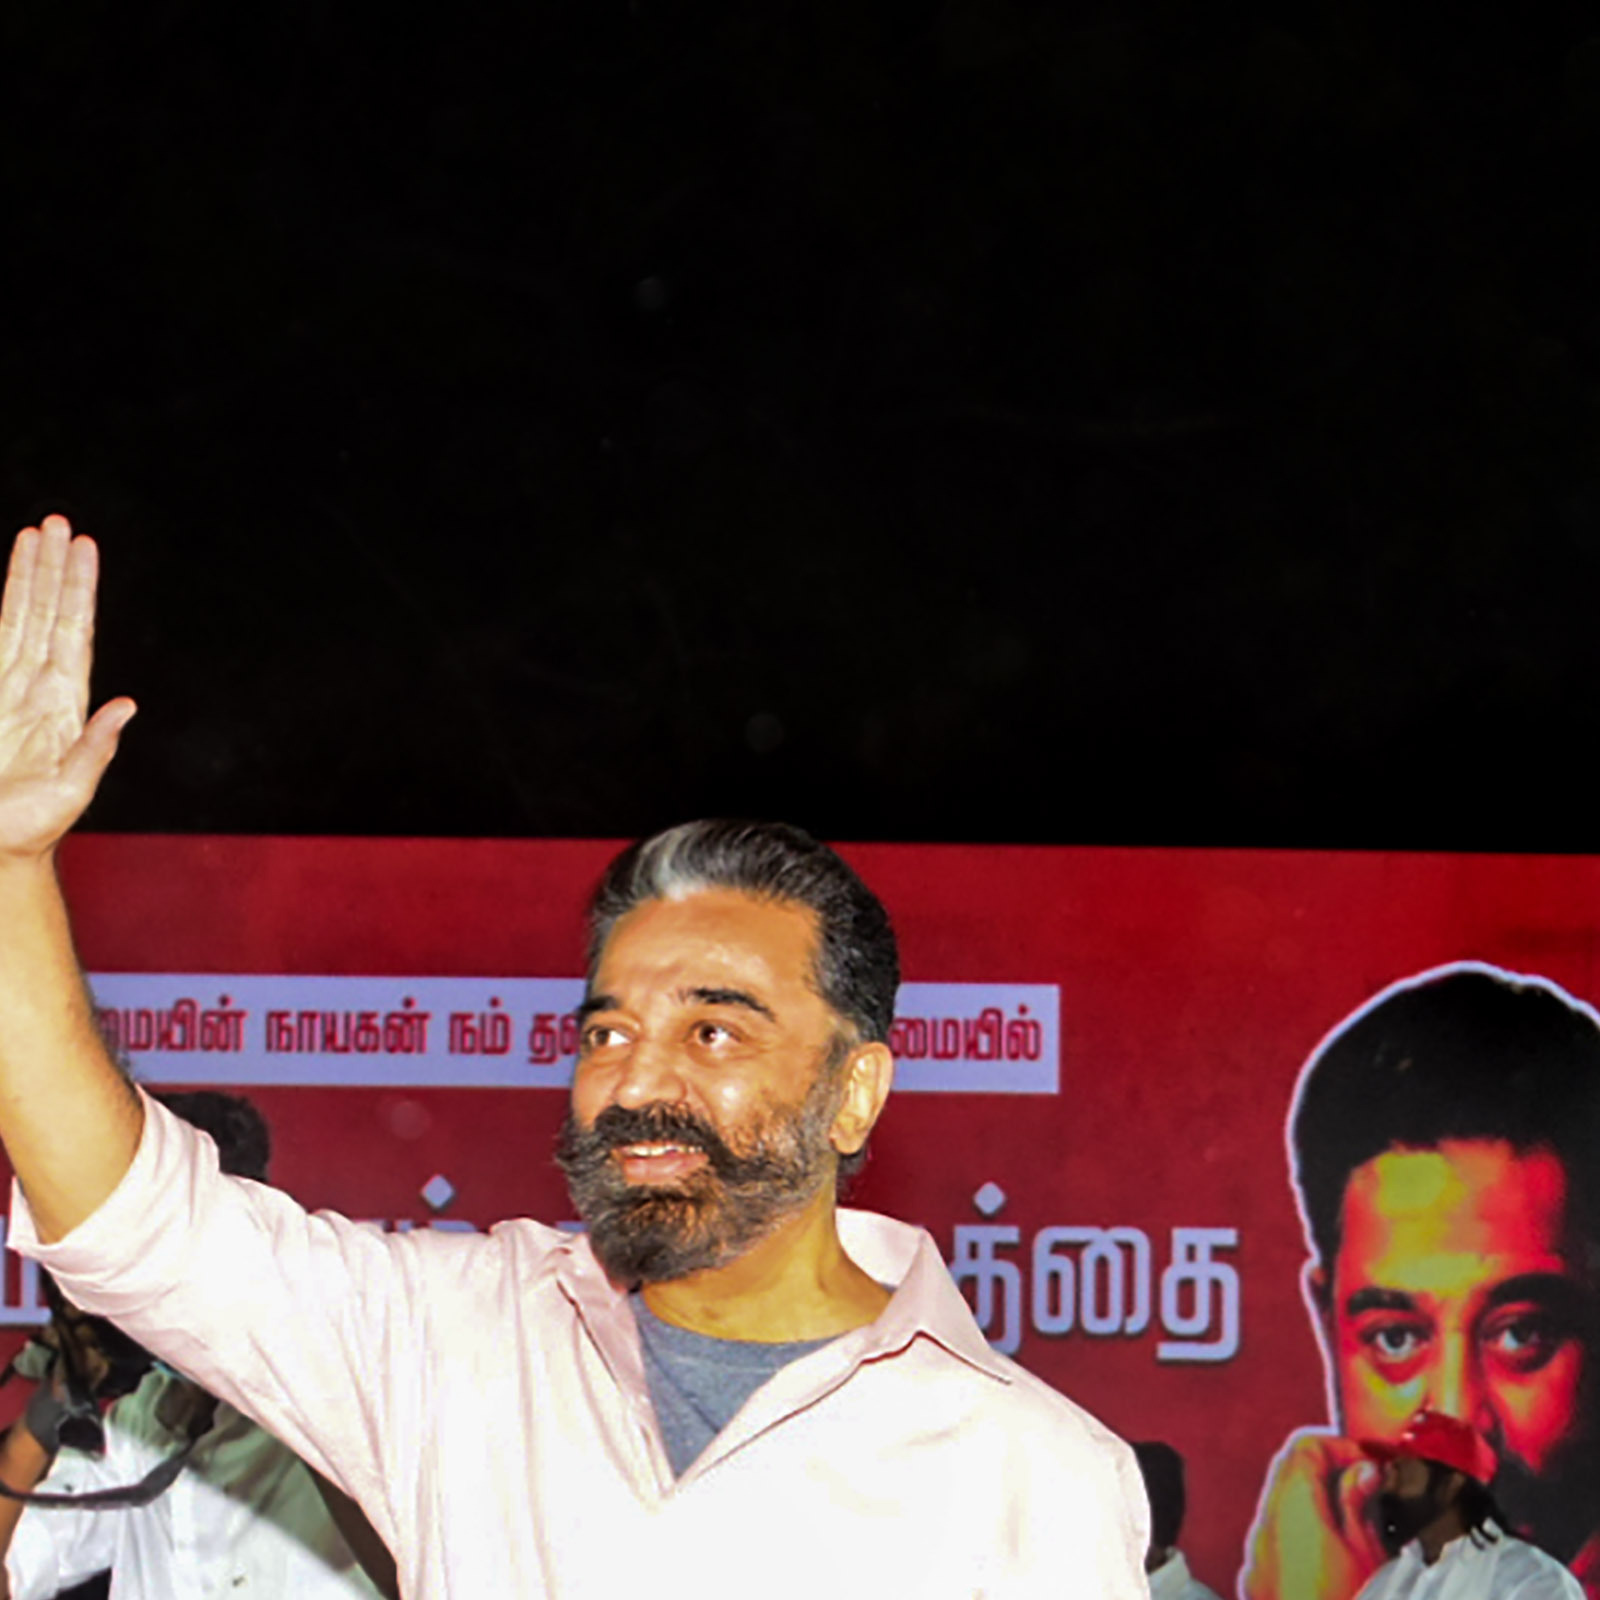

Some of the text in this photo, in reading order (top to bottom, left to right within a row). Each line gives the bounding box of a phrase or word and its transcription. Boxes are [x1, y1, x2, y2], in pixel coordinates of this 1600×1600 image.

[265, 997, 431, 1055] நாயகன்
[448, 997, 511, 1056] நம்
[888, 1003, 1044, 1062] மையில்
